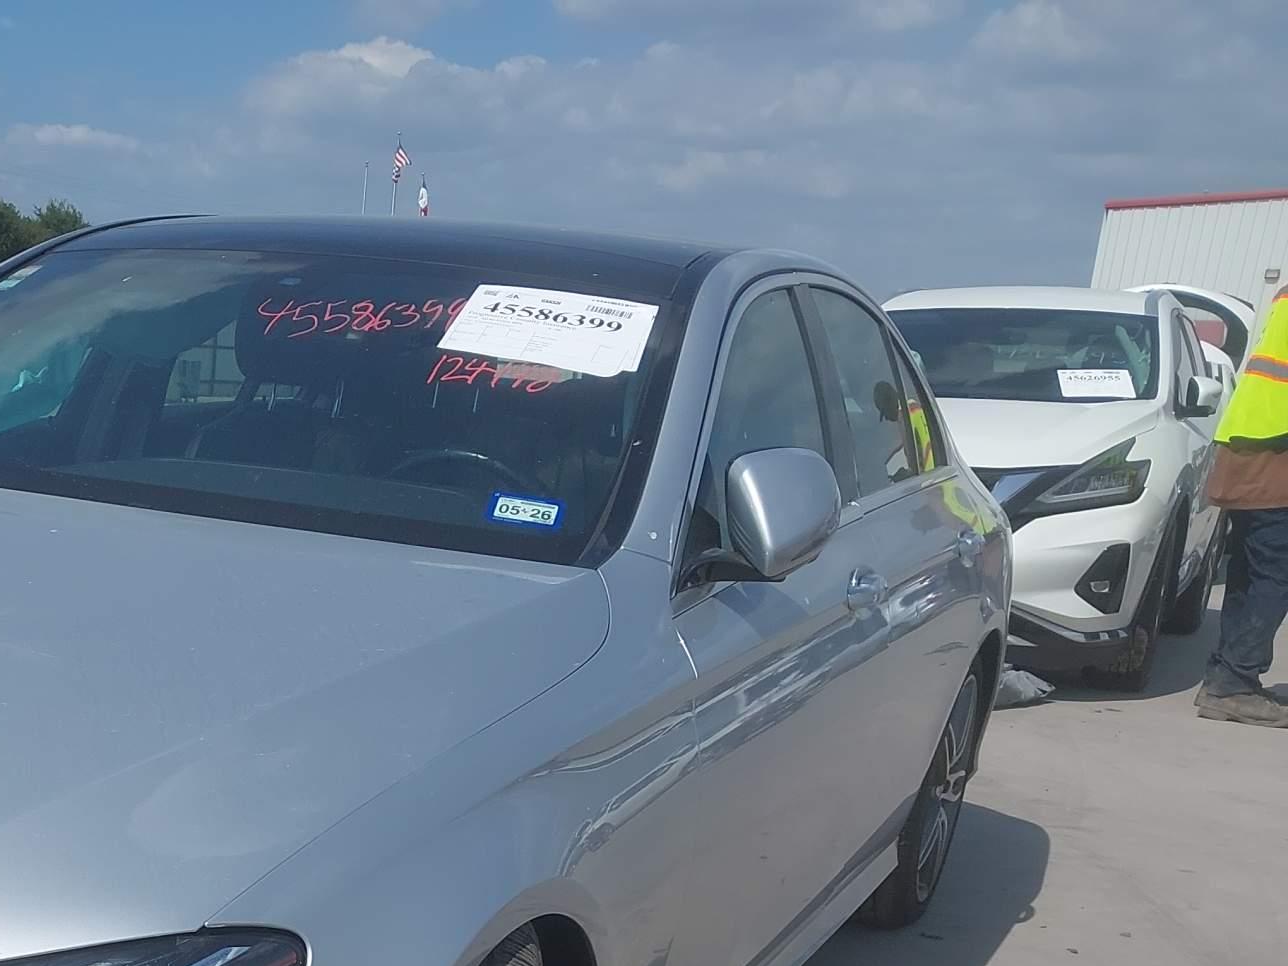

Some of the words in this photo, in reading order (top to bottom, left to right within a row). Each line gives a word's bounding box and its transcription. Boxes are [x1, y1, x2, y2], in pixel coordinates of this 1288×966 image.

[482, 301, 623, 333] 45586399
[499, 503, 521, 515] 05
[529, 508, 552, 520] 26
